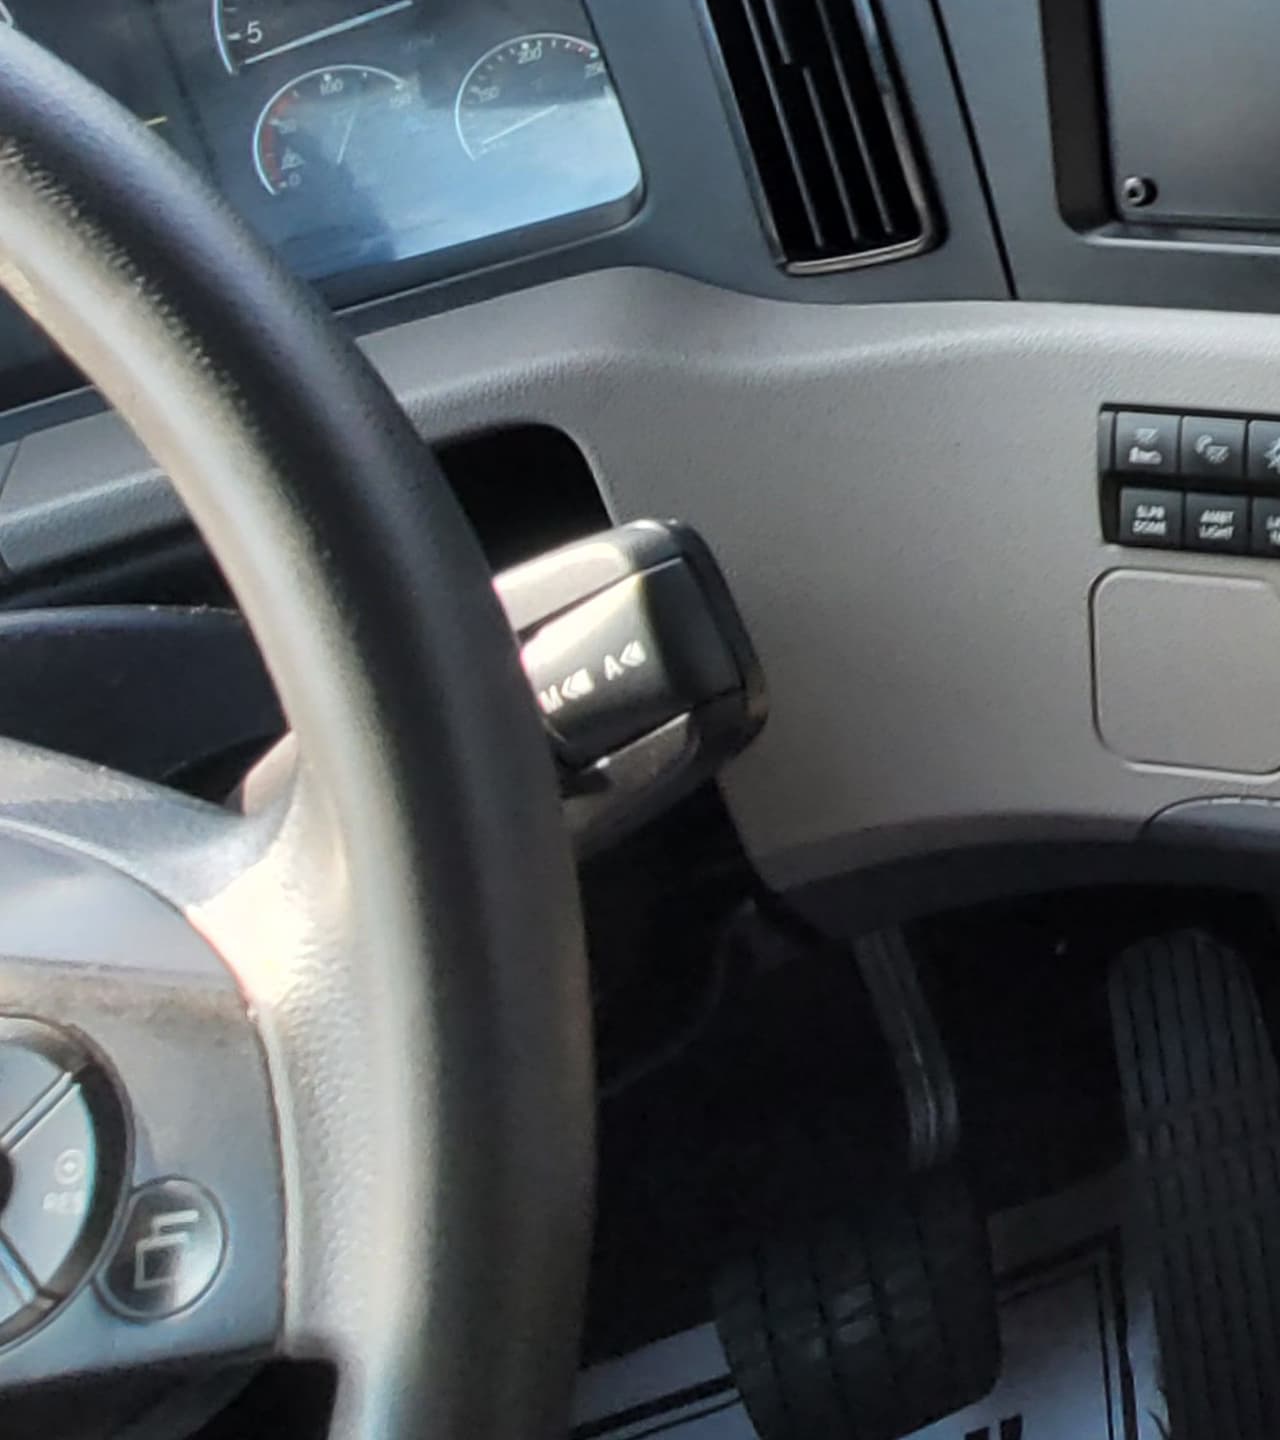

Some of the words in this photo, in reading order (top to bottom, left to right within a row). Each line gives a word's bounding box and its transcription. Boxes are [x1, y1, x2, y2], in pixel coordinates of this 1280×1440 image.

[247, 21, 263, 44] 5
[517, 46, 542, 64] 200
[1199, 524, 1234, 540] LIGHT
[603, 653, 625, 681] A
